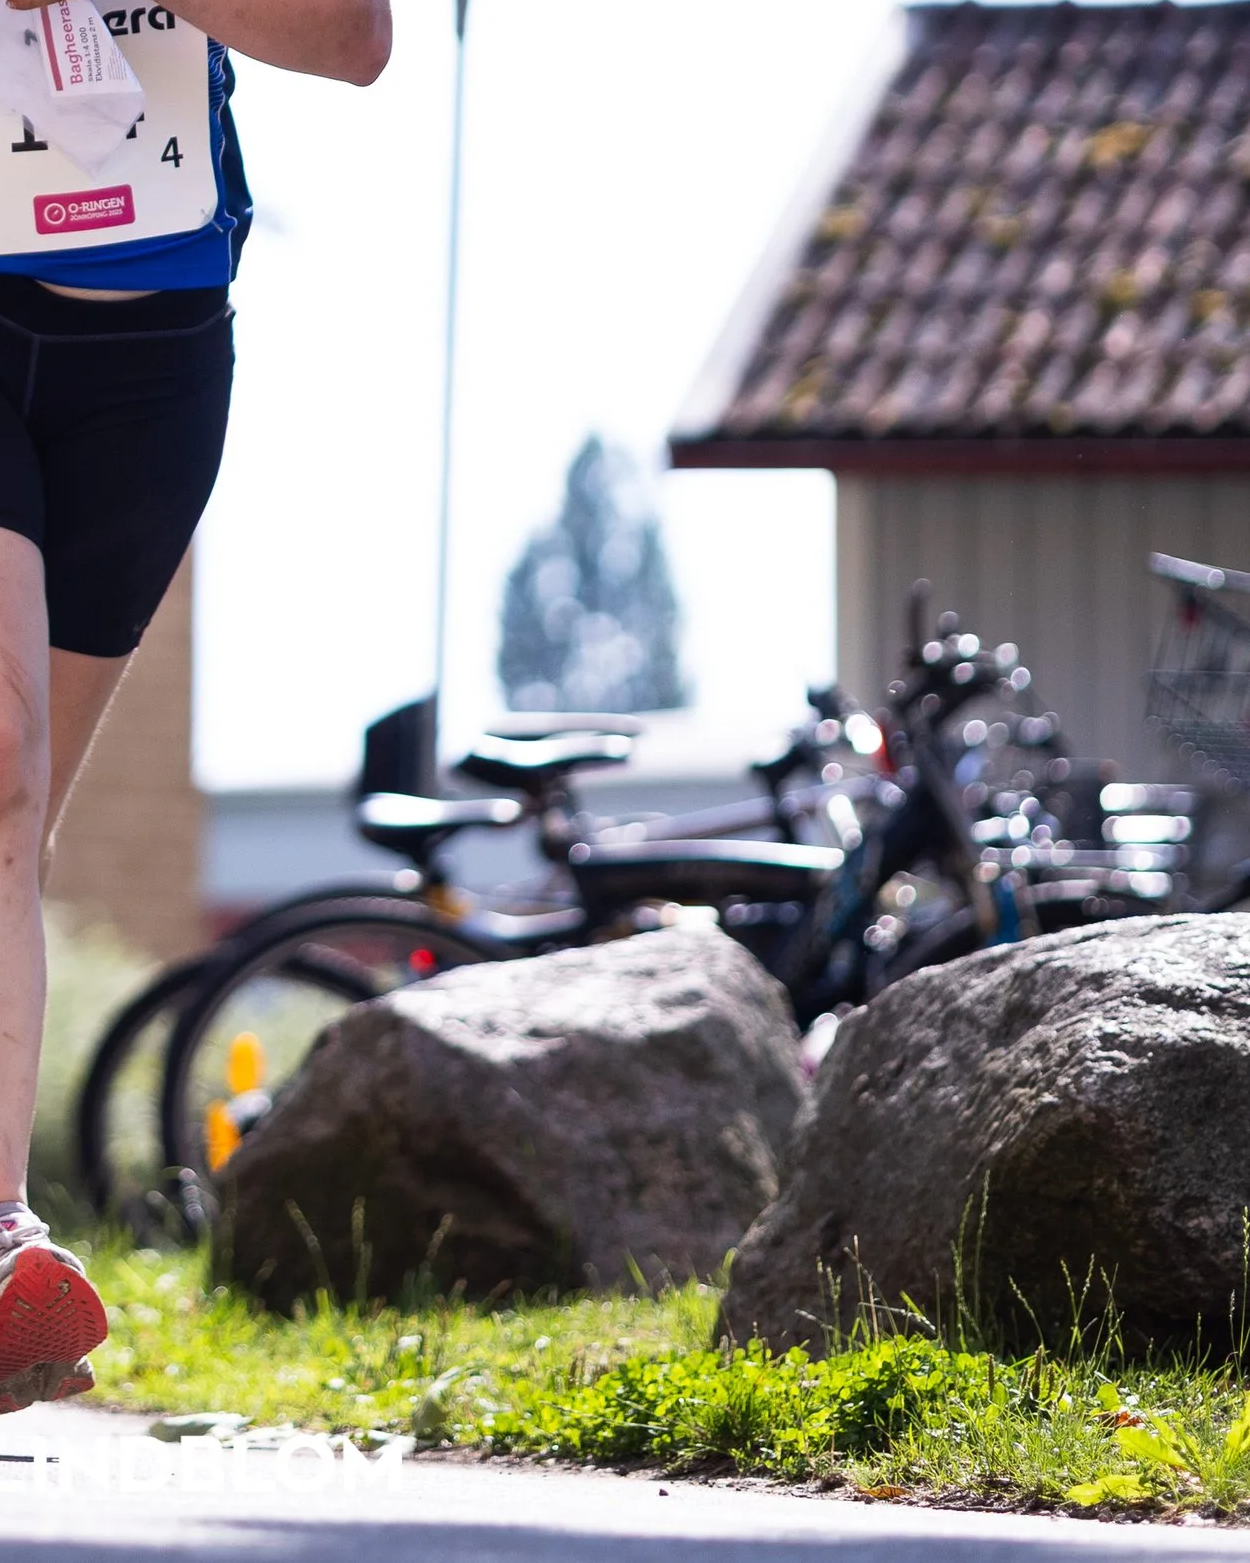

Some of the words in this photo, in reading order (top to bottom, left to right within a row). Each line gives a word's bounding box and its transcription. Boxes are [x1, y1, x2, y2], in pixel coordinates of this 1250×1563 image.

[92, 34, 102, 82] Ekvidistans
[160, 136, 183, 168] 4
[68, 196, 125, 213] O-RINGEN
